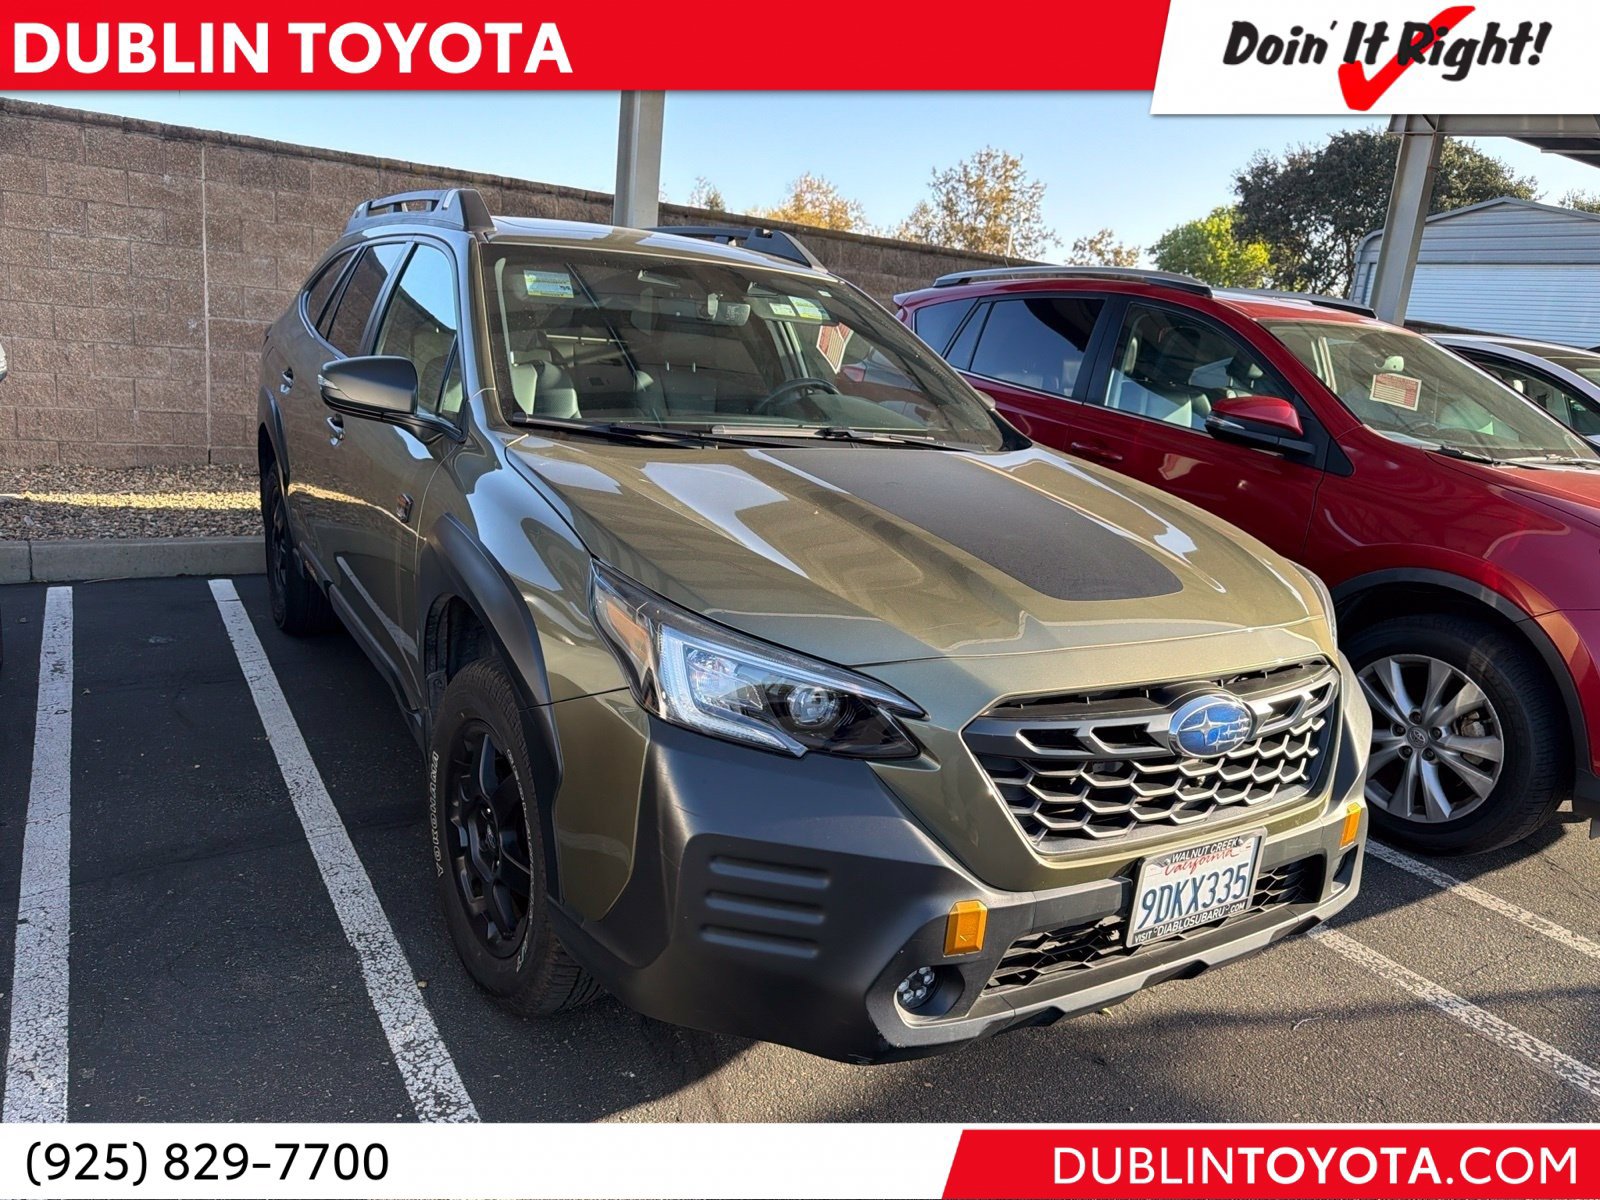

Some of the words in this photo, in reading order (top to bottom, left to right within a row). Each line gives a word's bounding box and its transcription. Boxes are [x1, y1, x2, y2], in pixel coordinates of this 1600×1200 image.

[1164, 848, 1239, 876] California
[1171, 845, 1211, 863] WALNUT
[1210, 838, 1238, 854] CREEK
[1137, 863, 1249, 930] 9DKX335
[1134, 930, 1153, 944] VISIT
